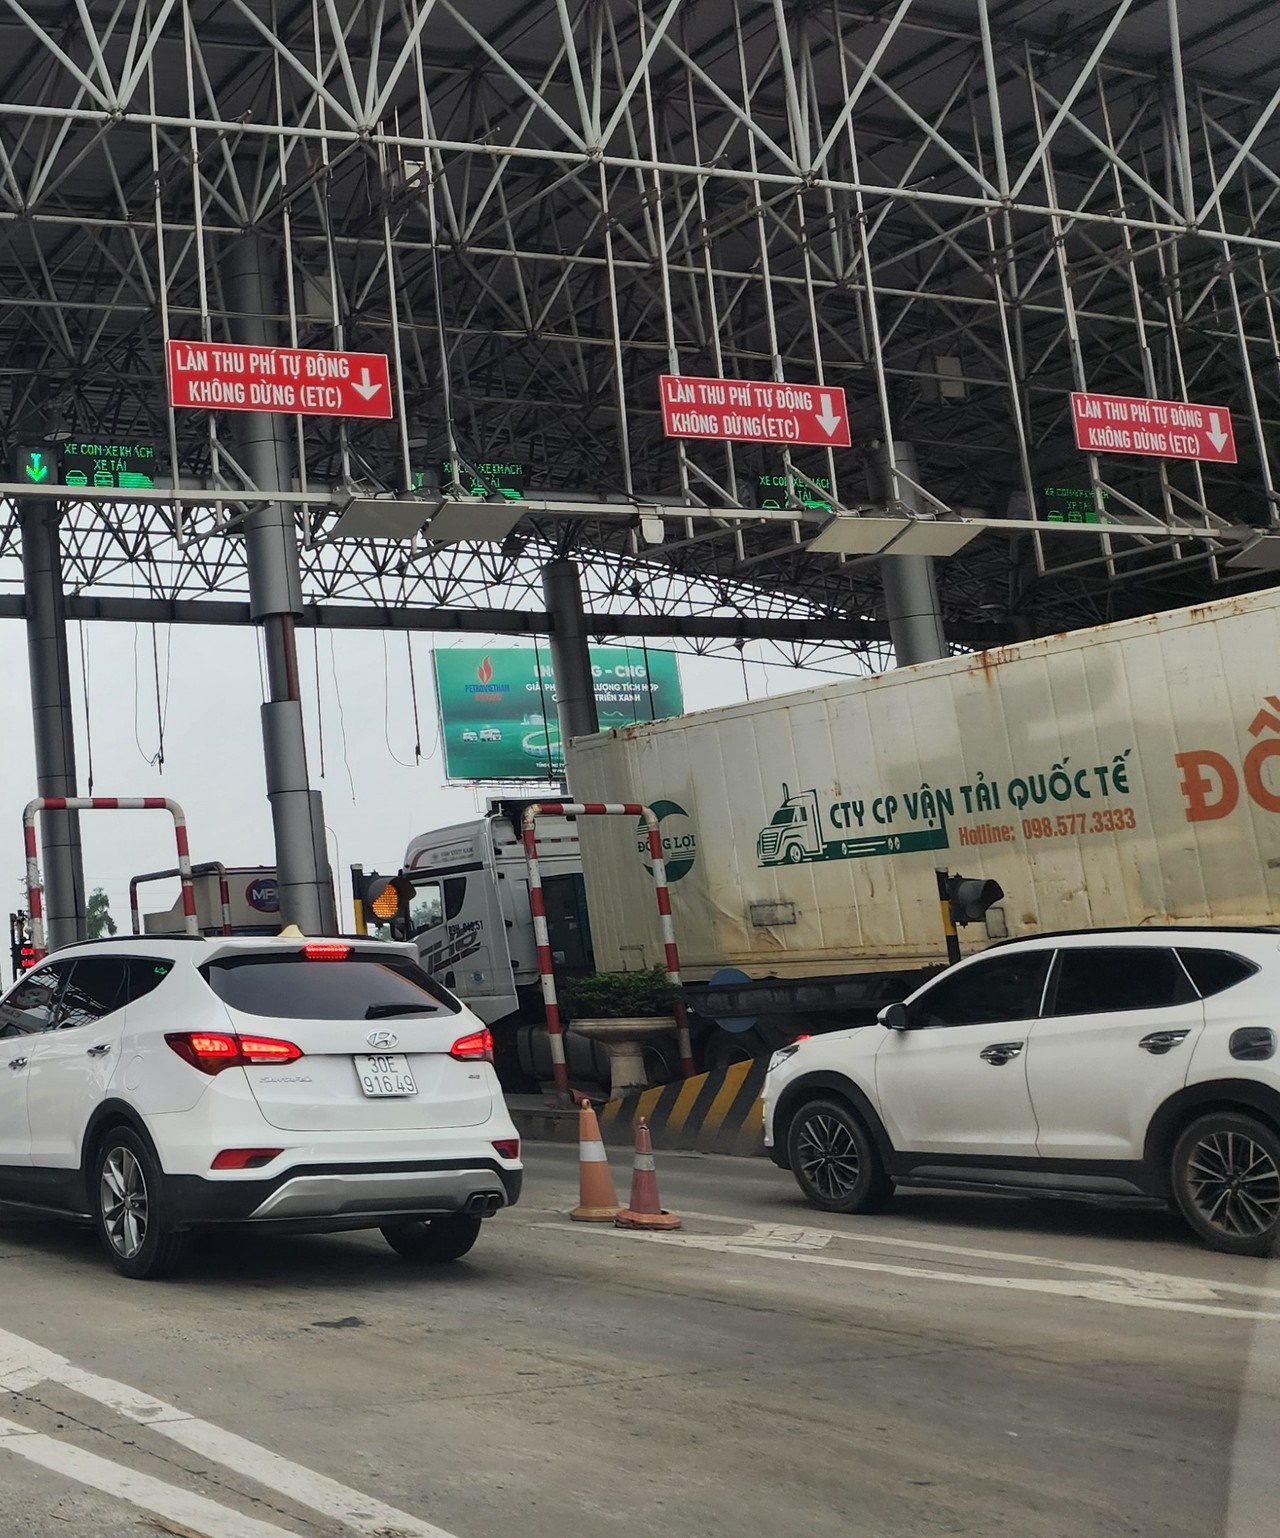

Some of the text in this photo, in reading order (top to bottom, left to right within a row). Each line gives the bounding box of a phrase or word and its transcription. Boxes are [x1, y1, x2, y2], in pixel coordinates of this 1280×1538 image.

[176, 345, 349, 380] LÀN THU PHÍ TỰ ĐỘNG
[189, 378, 342, 408] KHÔNG DỪNG (ETC)
[668, 379, 812, 413] LÀN THU PHÍ TỰ ĐỘNG
[1077, 396, 1202, 430] LÀN THU PHÍ TỰ ĐỘNG
[672, 411, 718, 434] KHÔNG
[64, 443, 77, 454] XE
[1089, 426, 1200, 455] KHÔNG DỪNG (ETC)
[94, 459, 107, 470] XE
[759, 476, 770, 485] XE
[614, 665, 646, 677] CNG
[622, 682, 640, 691] TÍCH
[830, 749, 1131, 828] CTY CP VẬN TẢI QUỐC TẾ
[959, 807, 1136, 846] Hotline: 098.577.3333
[674, 834, 696, 850] LỢI
[252, 889, 279, 900] MP
[368, 1057, 398, 1073] 30E
[364, 1075, 414, 1092] 916.49
